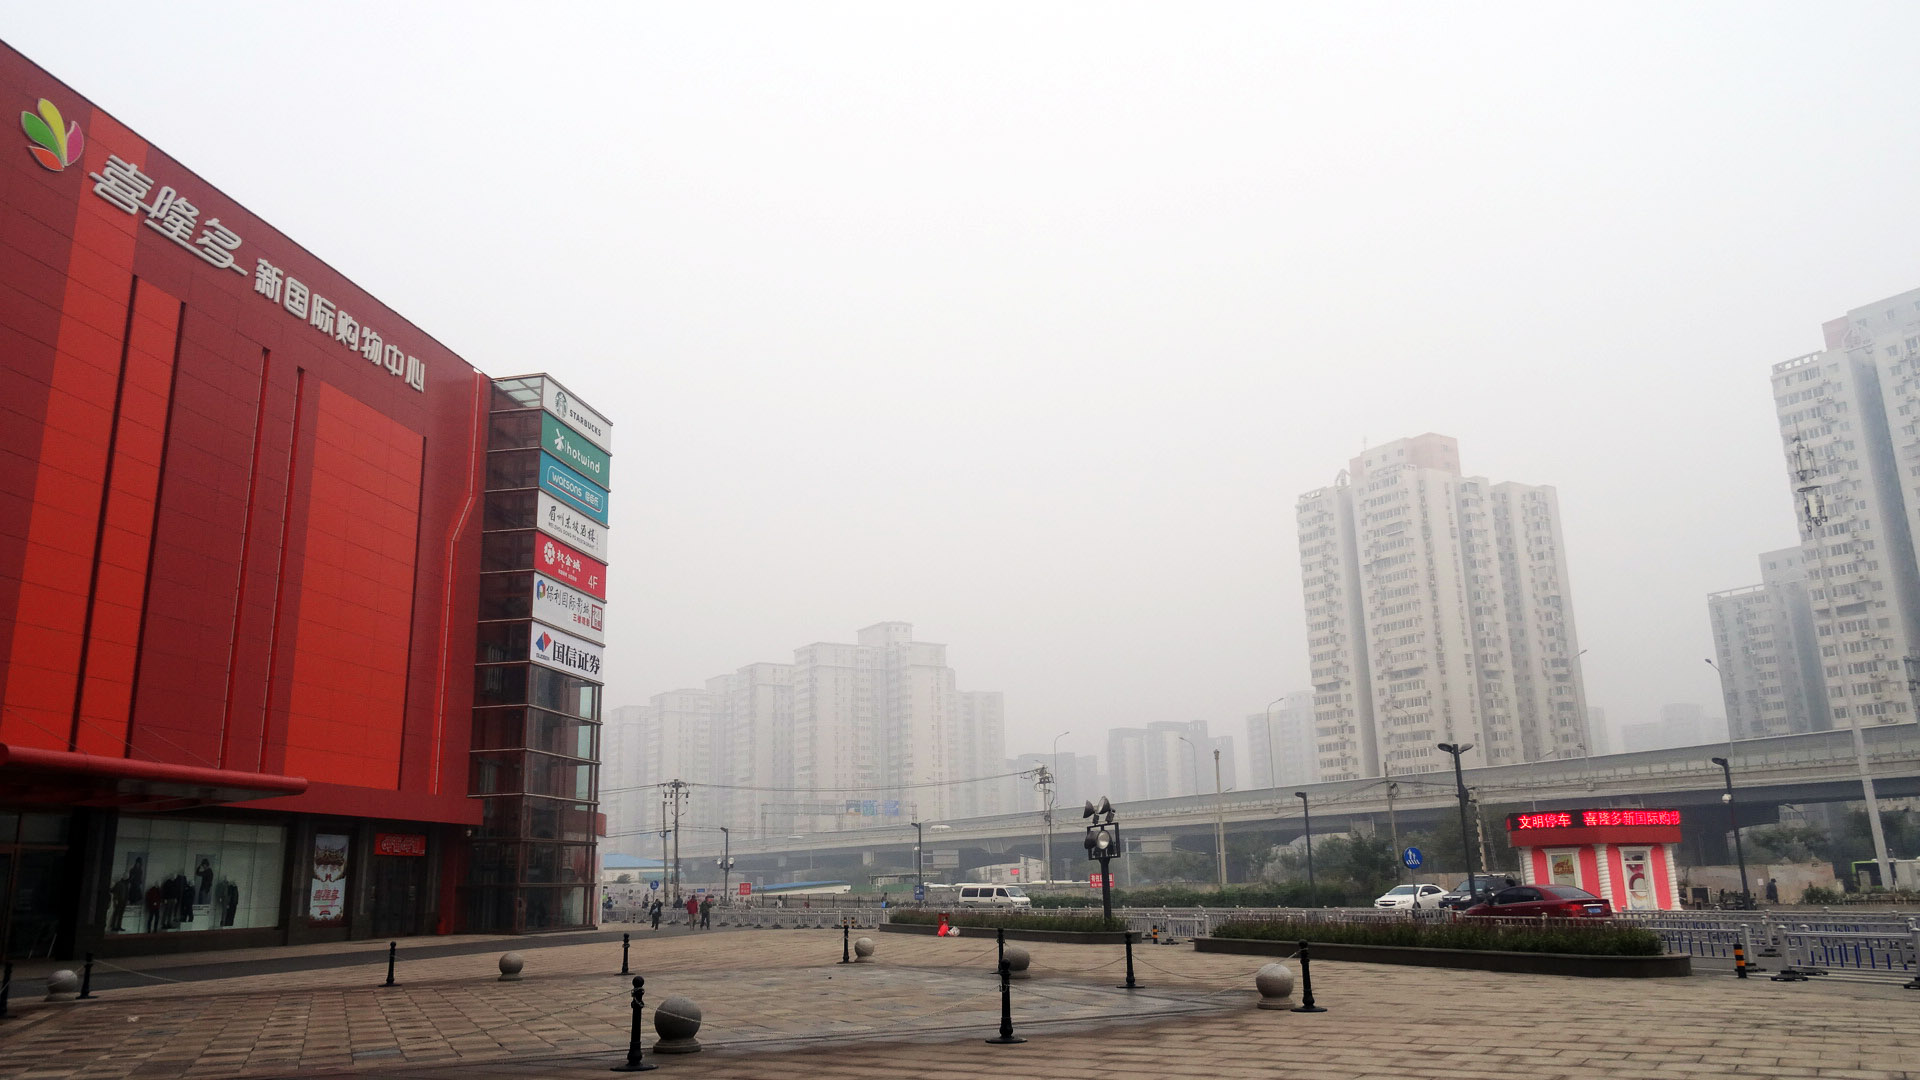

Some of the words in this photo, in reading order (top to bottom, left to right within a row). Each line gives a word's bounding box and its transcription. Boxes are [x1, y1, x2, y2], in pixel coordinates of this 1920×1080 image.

[89, 154, 249, 277] 喜隆多
[254, 257, 426, 393] 新国际购物中心
[569, 409, 602, 437] STARBUCKS
[566, 442, 600, 473] hotwind
[552, 472, 582, 497] watsons
[556, 549, 581, 572] 权金城
[587, 574, 598, 590] 4F
[546, 585, 590, 618] 保利国际影城
[552, 640, 600, 675] 国信证券
[1518, 812, 1572, 829] 文明停车
